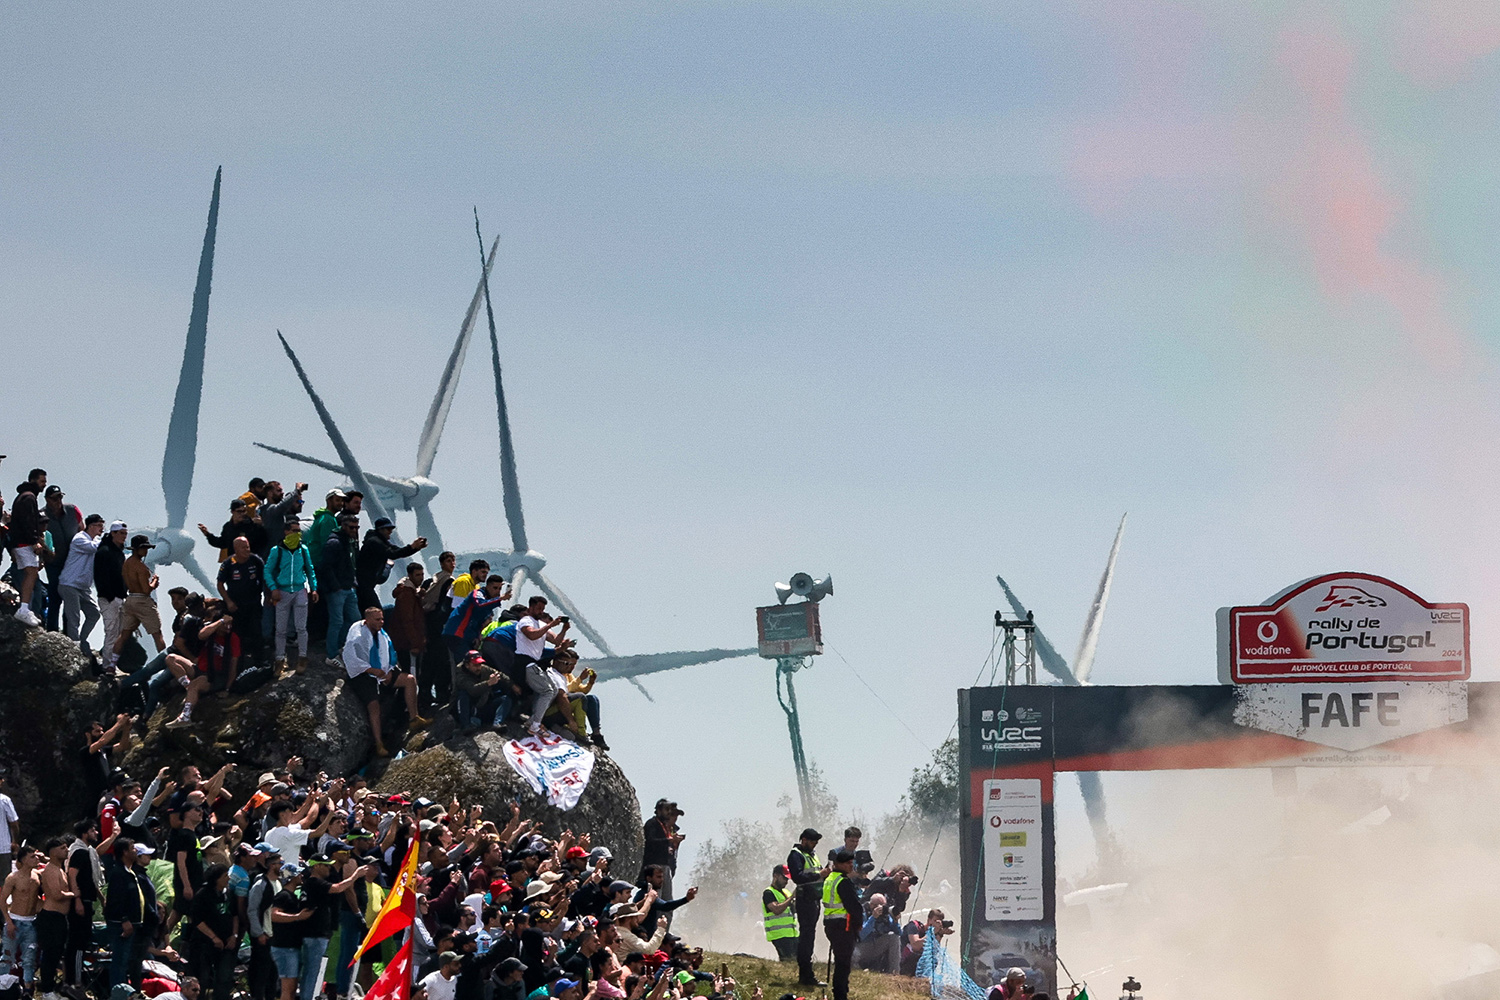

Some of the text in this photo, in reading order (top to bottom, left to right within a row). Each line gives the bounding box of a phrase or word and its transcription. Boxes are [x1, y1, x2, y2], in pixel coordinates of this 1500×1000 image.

[1430, 611, 1461, 620] WRC
[1308, 617, 1380, 632] rally de
[1305, 631, 1436, 653] Portugal
[1245, 645, 1291, 655] vodafone
[1442, 649, 1462, 657] 2024
[1291, 662, 1413, 672] AUTOMÓVEL CLUB DE PORTUGAL
[1301, 692, 1400, 728] FAFE
[981, 727, 1042, 741] WRC
[1003, 817, 1035, 825] vodafone
